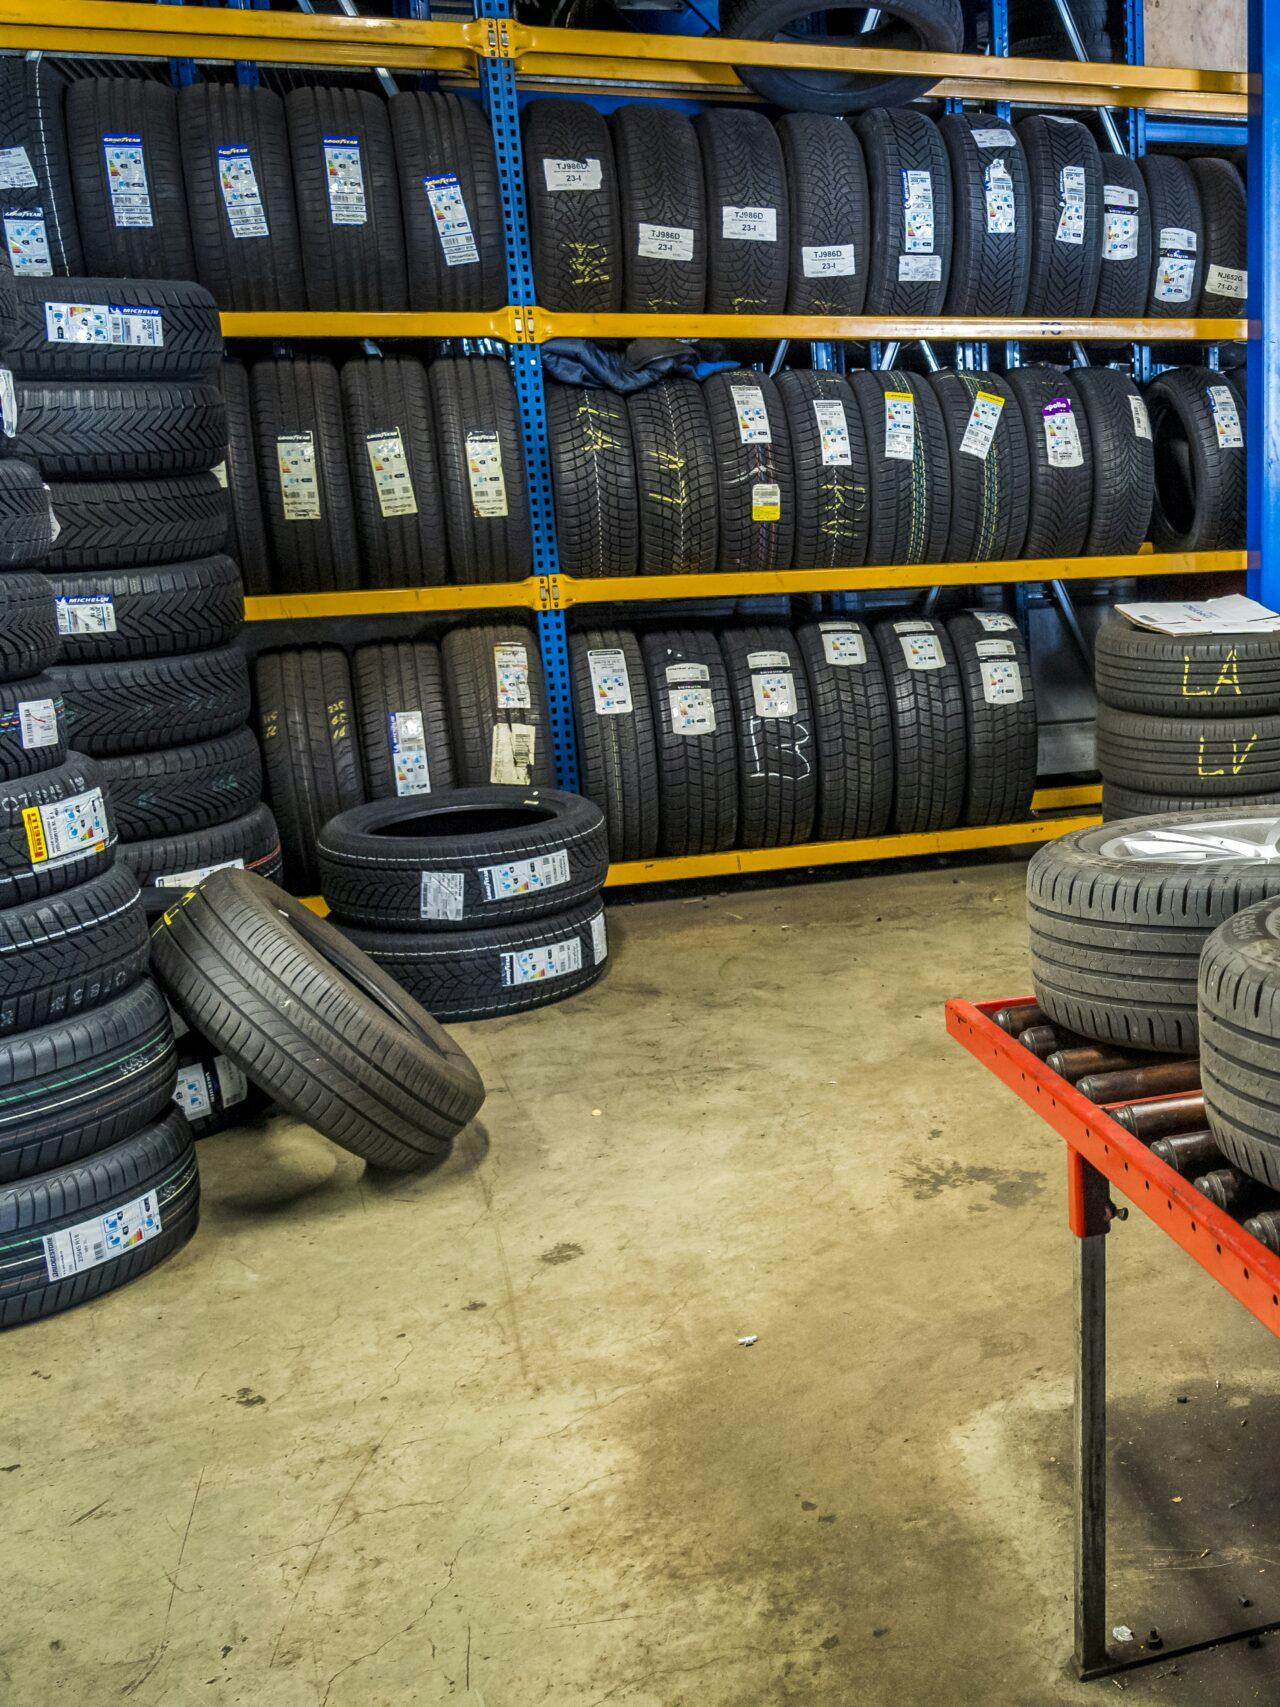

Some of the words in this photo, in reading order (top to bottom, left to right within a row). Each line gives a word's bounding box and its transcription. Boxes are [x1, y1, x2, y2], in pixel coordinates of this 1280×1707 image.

[733, 211, 764, 220] TJ986D
[651, 229, 681, 240] TJ986D
[813, 249, 842, 259] TJ986D
[122, 307, 160, 315] MICHELIN
[68, 596, 110, 604] MICHELIN
[1181, 648, 1242, 697] LA
[1197, 733, 1259, 777] LV
[45, 1236, 60, 1279] BRIDGESTONE
